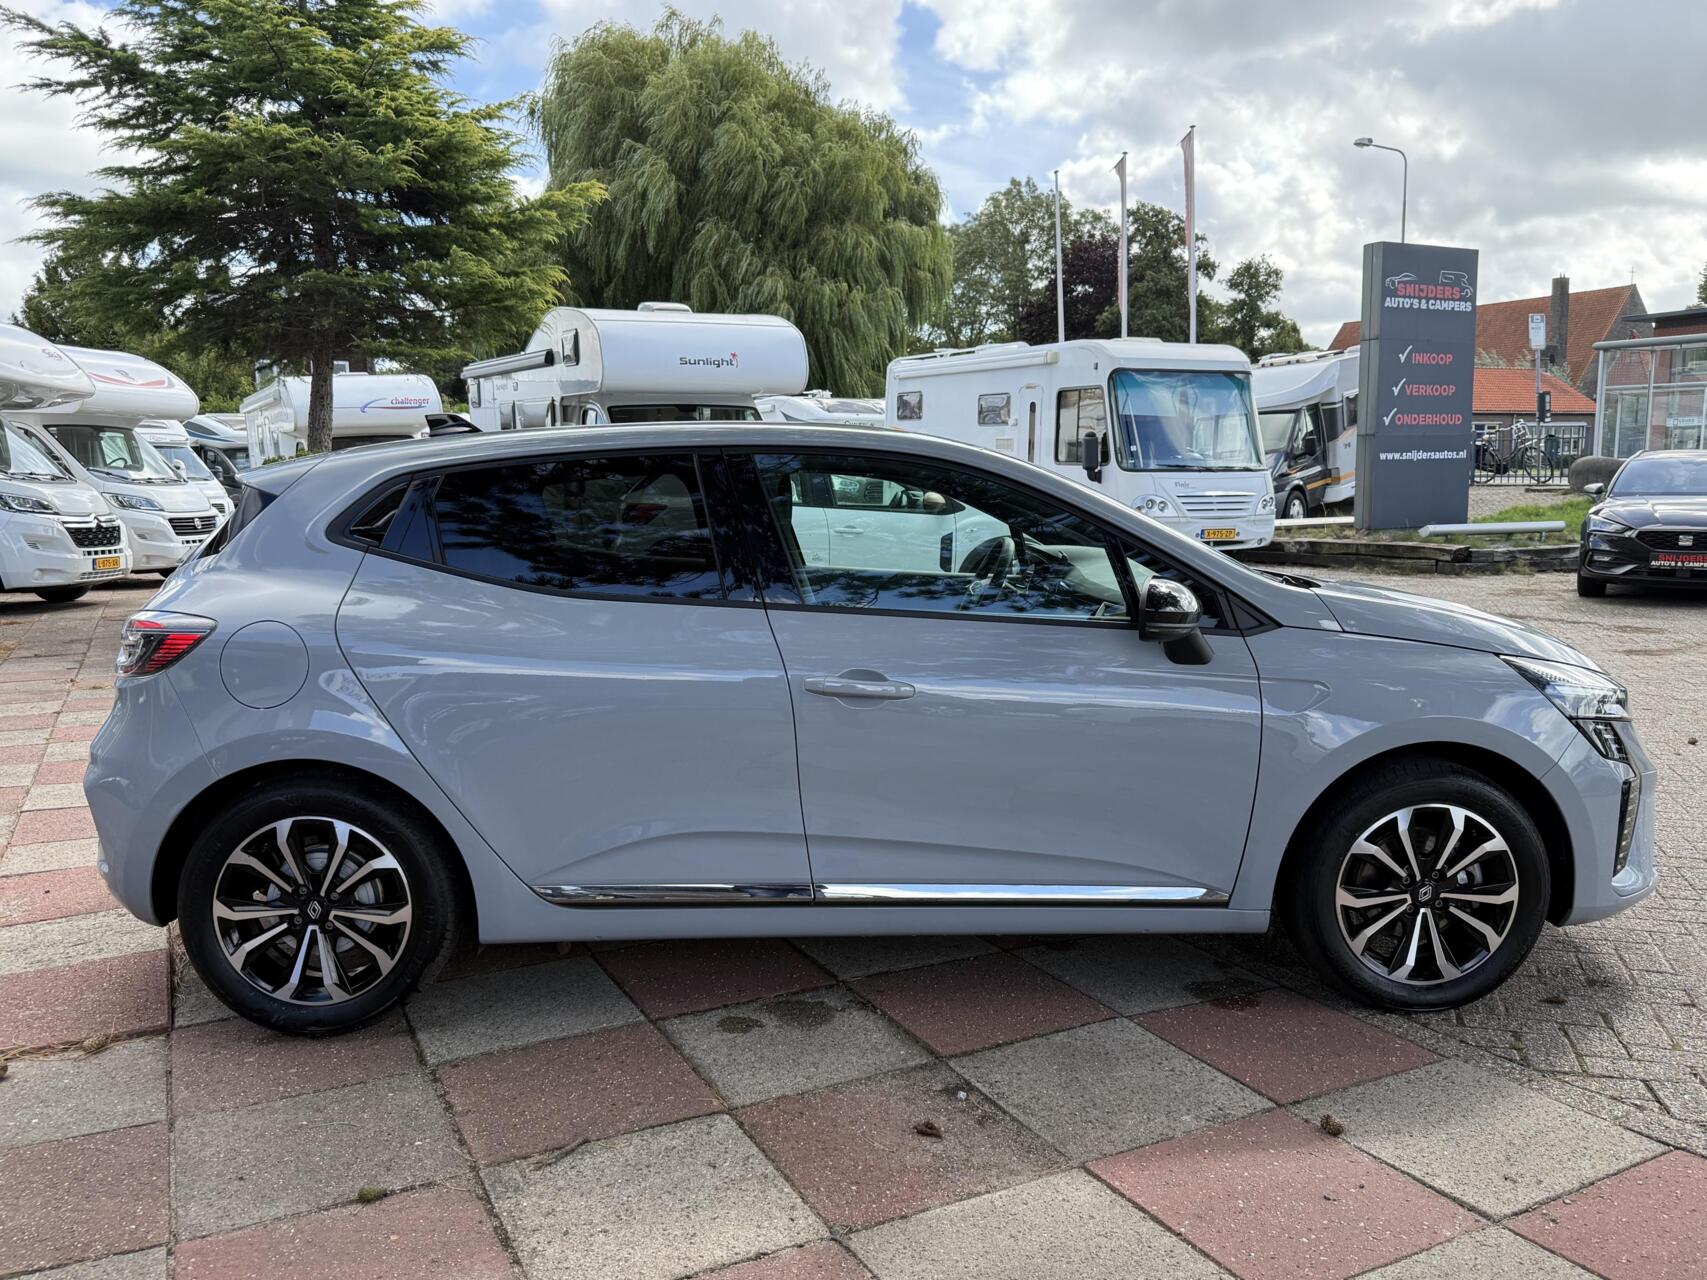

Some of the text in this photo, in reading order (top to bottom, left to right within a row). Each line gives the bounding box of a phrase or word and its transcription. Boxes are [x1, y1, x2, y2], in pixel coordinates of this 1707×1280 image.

[1397, 283, 1461, 299] SNIJDERS
[1384, 297, 1472, 312] AUTO'S & CAMPERS
[679, 356, 735, 368] Sunlight
[1412, 353, 1453, 365] INKOOP
[1405, 384, 1456, 396] VERKOOP
[390, 396, 430, 407] challenger
[1395, 414, 1463, 425] ONDERHOUD
[1379, 449, 1467, 461] www.snijdersautos.nl
